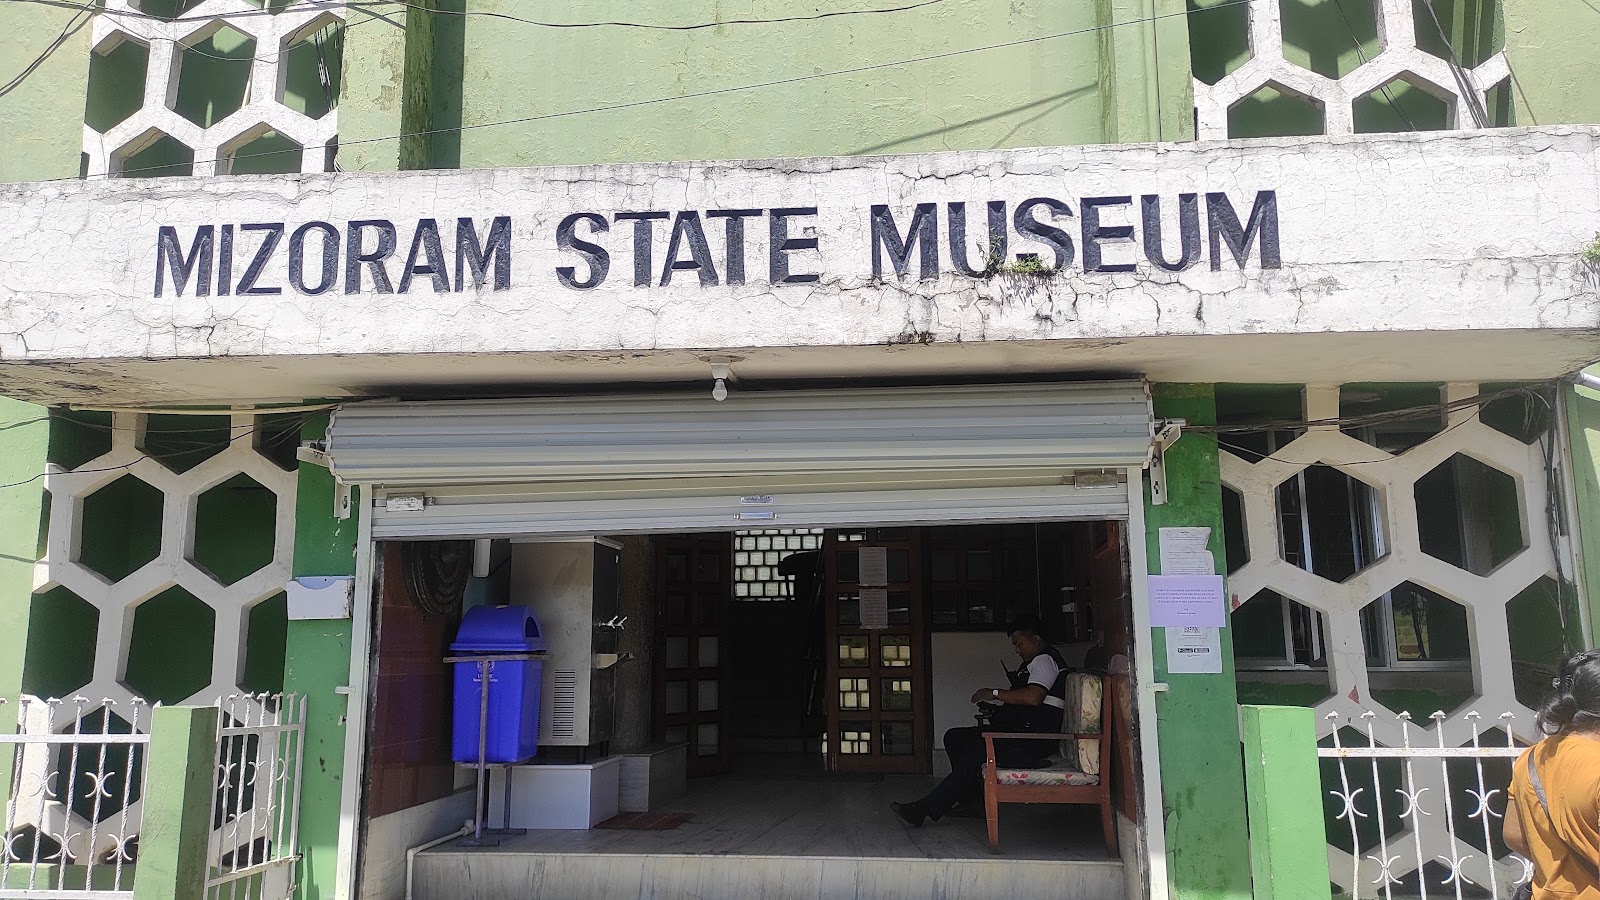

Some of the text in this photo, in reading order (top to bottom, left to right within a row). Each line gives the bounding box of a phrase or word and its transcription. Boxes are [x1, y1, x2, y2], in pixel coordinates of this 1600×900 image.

[154, 190, 1282, 298] MIZORAM STATE MUSEUM
